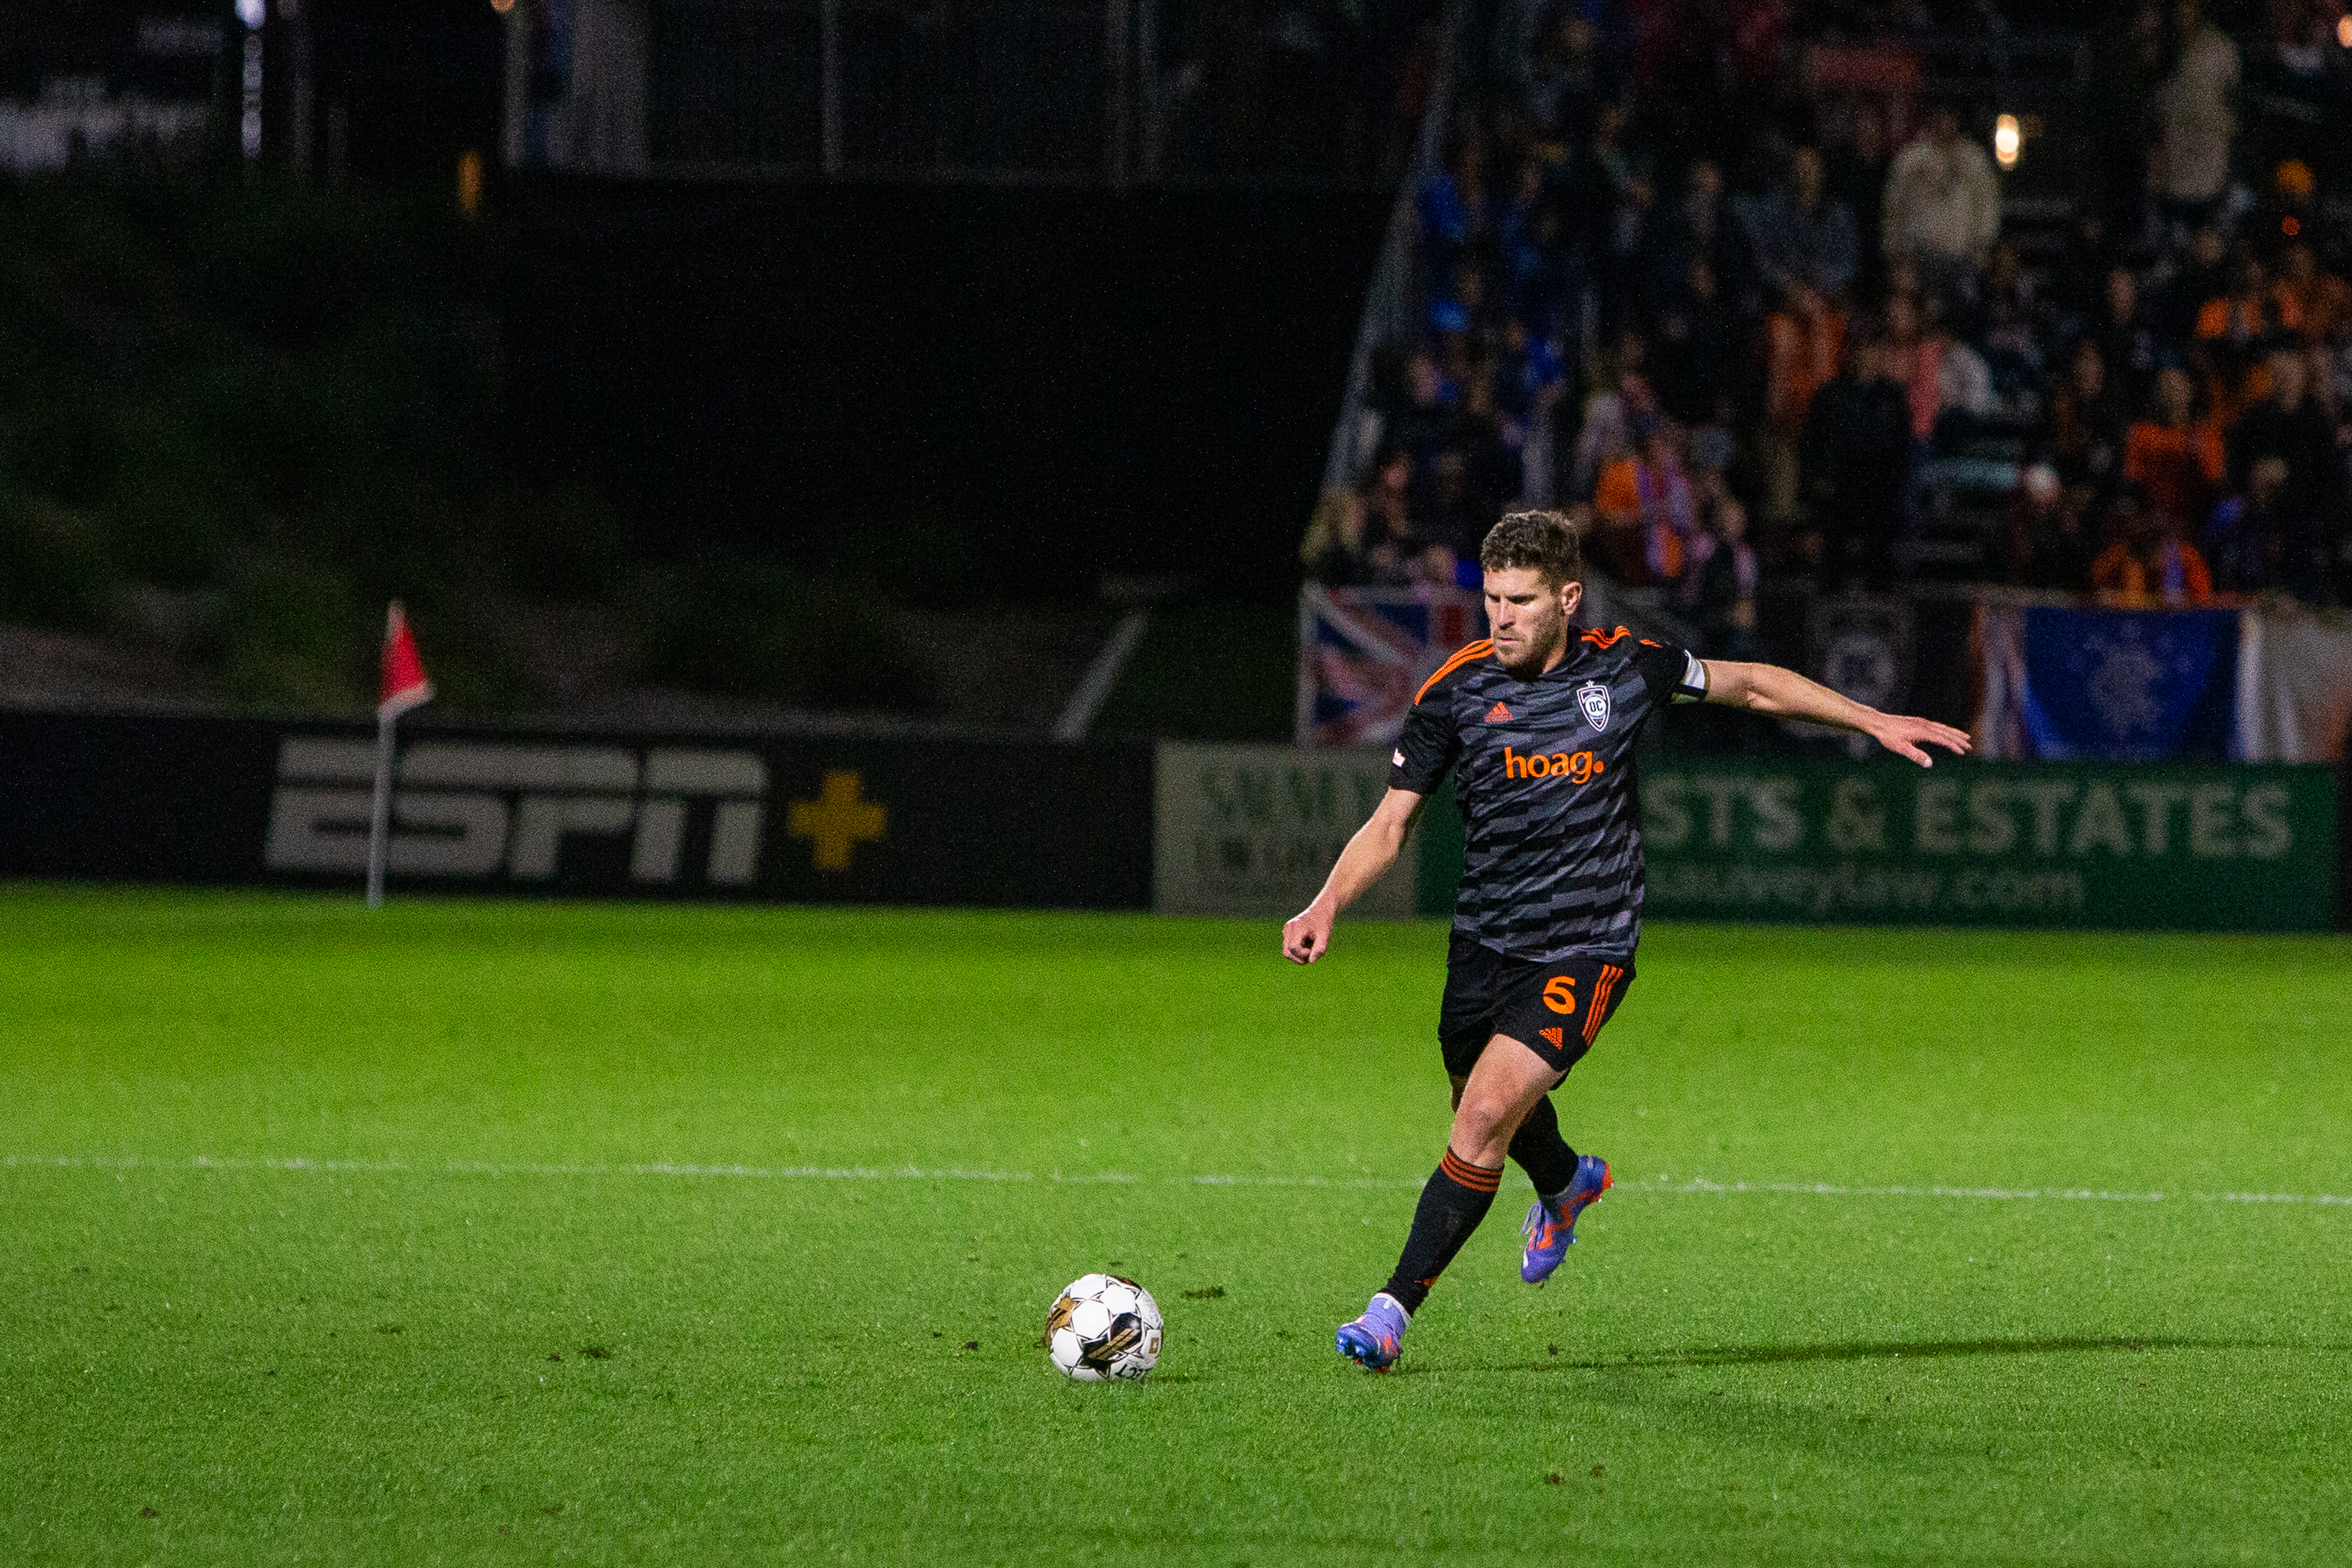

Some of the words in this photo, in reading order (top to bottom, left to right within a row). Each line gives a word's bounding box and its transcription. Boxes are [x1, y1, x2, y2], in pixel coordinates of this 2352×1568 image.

[1589, 700, 1603, 712] OC
[1504, 746, 1605, 785] hoag.
[1823, 778, 1885, 851] &
[1915, 780, 2293, 860] ESTATES
